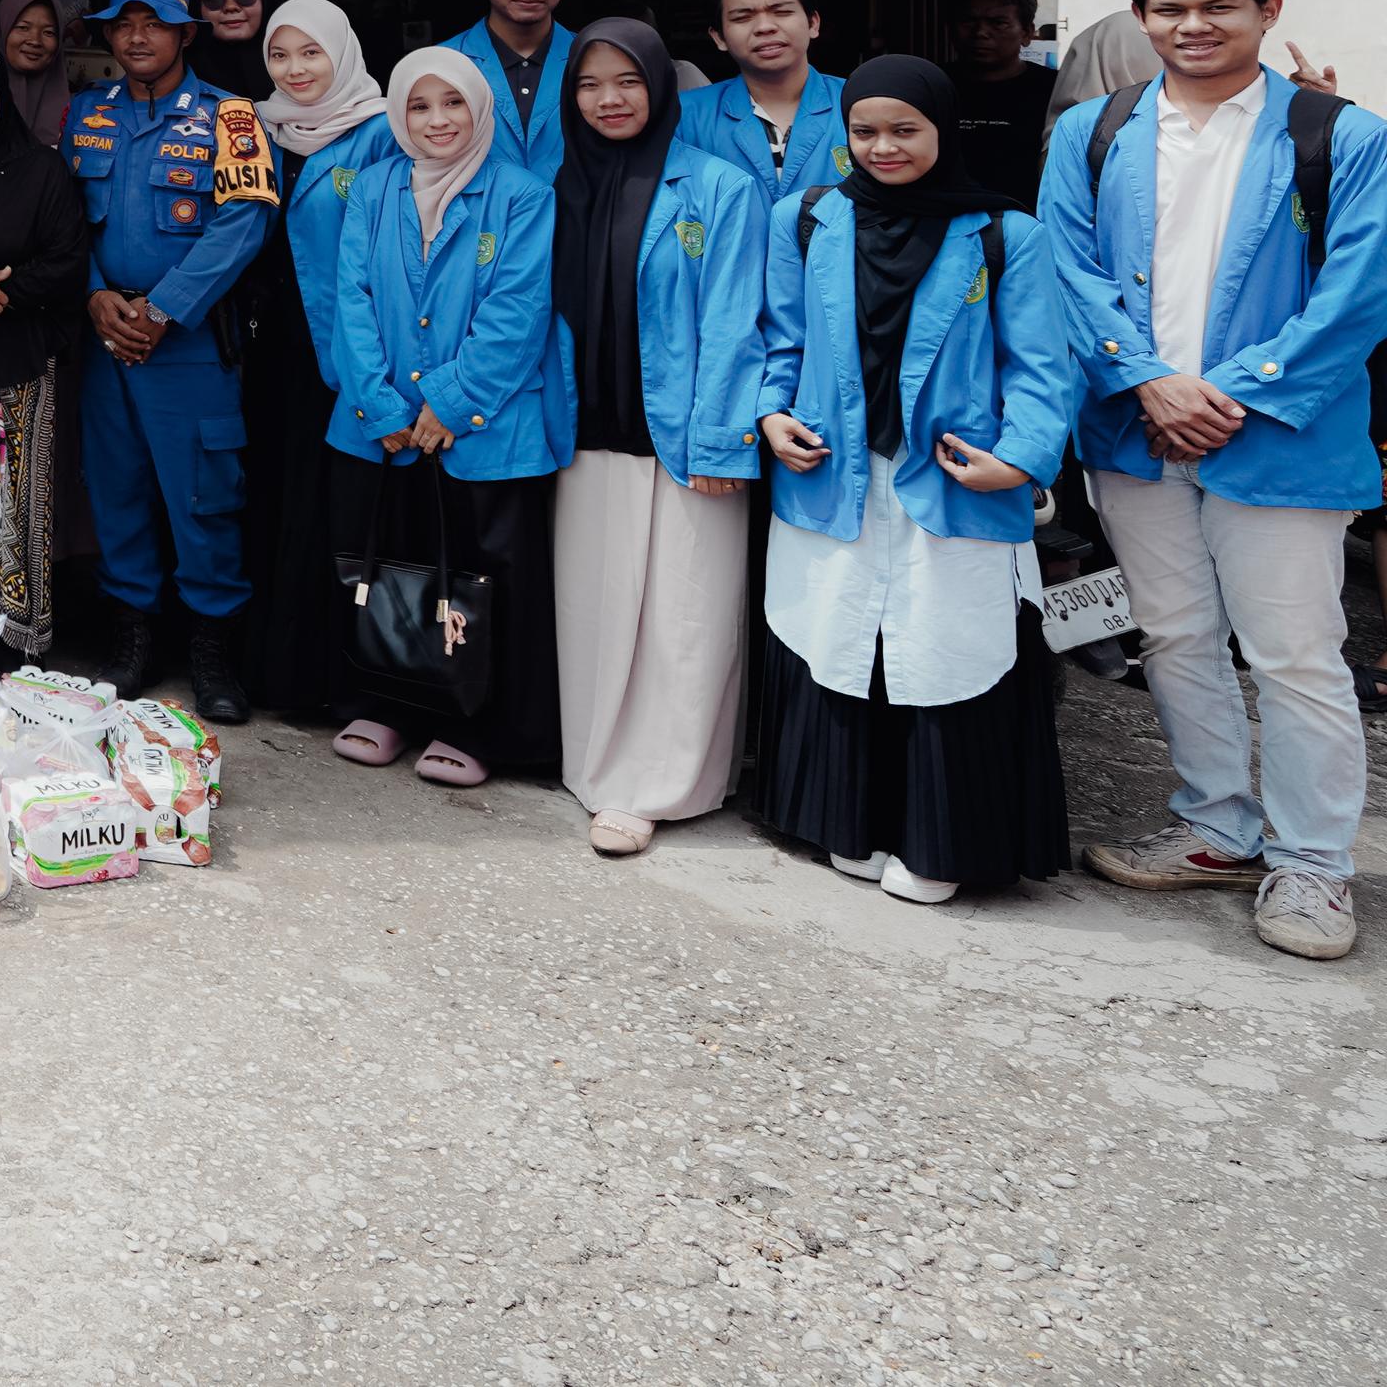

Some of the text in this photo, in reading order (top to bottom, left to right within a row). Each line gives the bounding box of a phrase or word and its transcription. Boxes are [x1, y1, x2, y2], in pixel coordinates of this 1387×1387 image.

[224, 110, 253, 123] POLDA
[160, 144, 210, 162] POLRI
[1051, 583, 1099, 614] 5360
[138, 701, 183, 730] MILKU
[142, 748, 164, 776] MILKU
[35, 779, 102, 795] MILKU
[62, 822, 125, 855] MILKU
